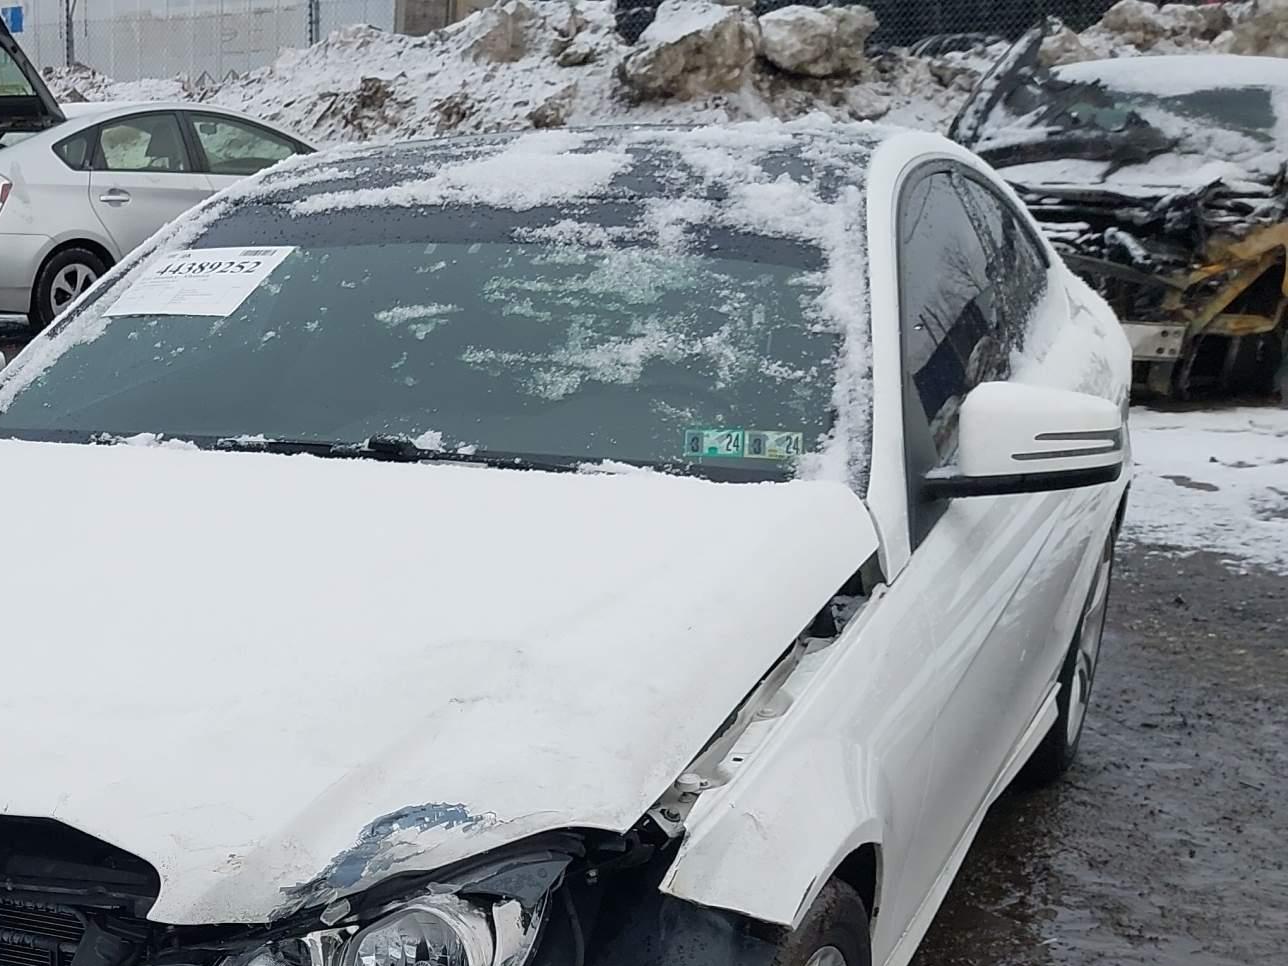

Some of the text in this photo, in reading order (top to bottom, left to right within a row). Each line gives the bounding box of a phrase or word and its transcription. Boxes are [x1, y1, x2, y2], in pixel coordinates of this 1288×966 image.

[157, 260, 261, 277] 44389252
[690, 433, 740, 453] 3 24
[752, 435, 800, 455] 3 24
